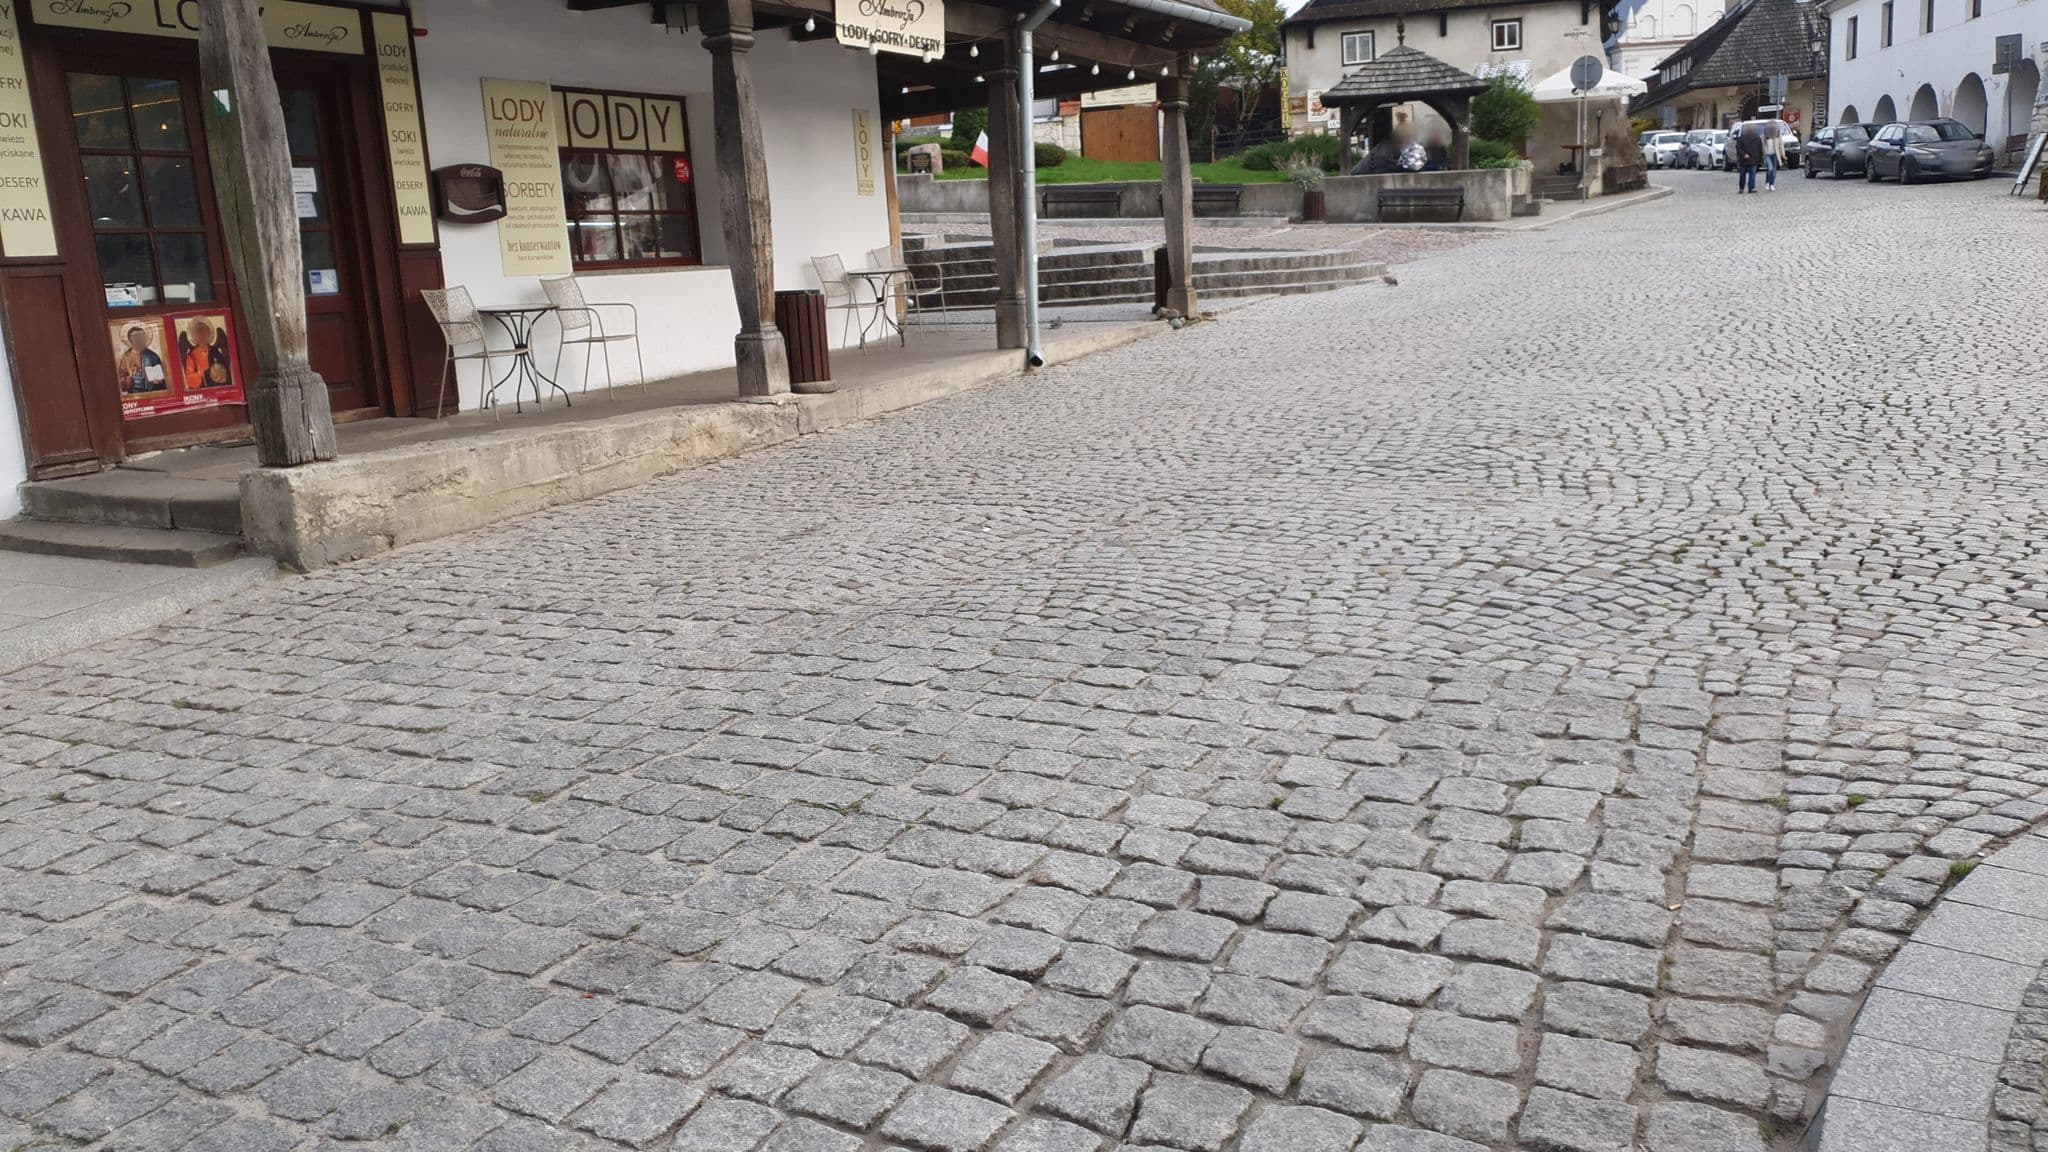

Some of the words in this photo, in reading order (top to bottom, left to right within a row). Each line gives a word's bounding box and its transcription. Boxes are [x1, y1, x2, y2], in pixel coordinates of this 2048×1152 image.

[843, 24, 868, 41] LODY
[874, 29, 904, 47] GOFRY
[909, 35, 940, 52] DESERY
[378, 44, 407, 58] LODY
[0, 76, 22, 89] FRY
[385, 102, 415, 112] GOFRY
[490, 97, 545, 122] LODY
[0, 112, 27, 128] OKI
[572, 98, 670, 143] ODY
[392, 130, 417, 143] SOKI
[859, 113, 869, 178] LODY
[396, 180, 424, 190] DESERY
[503, 181, 555, 198] SORBETY
[2, 208, 47, 221] KAWA
[400, 206, 428, 216] KAWA
